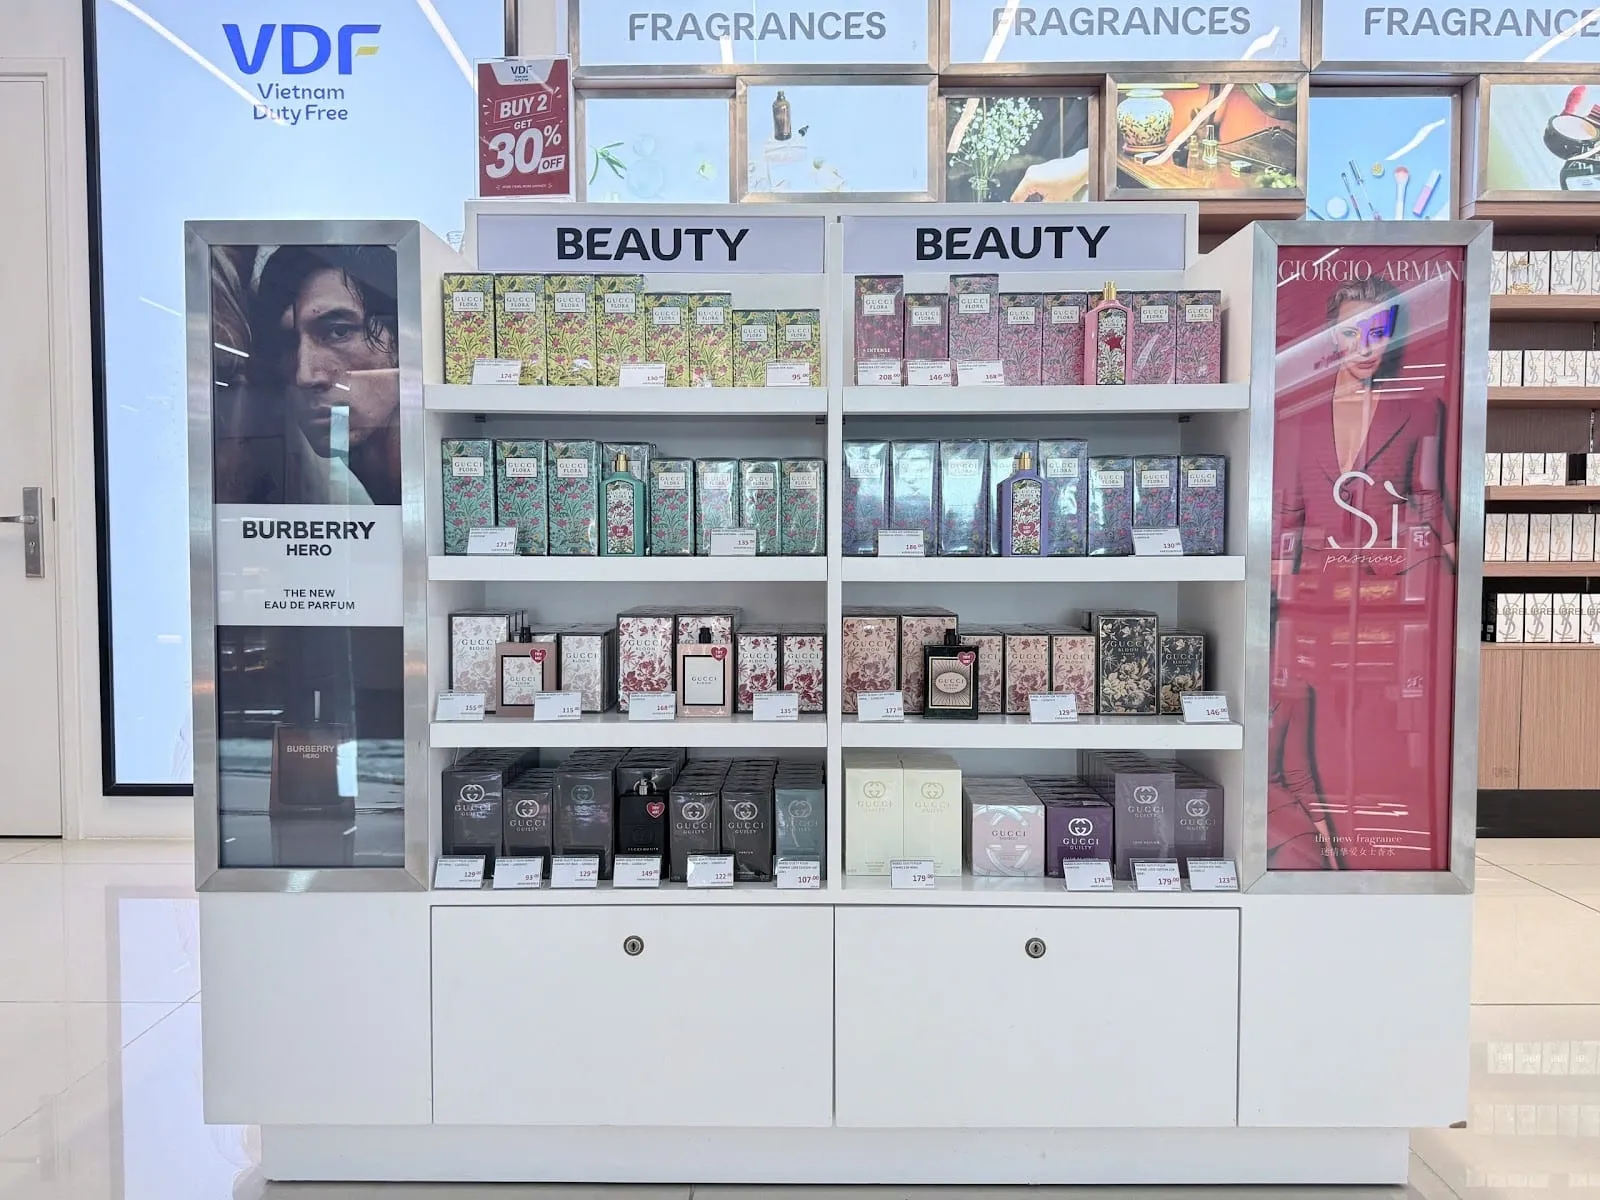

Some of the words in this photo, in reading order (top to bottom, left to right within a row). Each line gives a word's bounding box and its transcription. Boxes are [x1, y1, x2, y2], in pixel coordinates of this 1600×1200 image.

[629, 11, 886, 41] FRAGRANCES
[993, 6, 1250, 35] FRAGRANCES
[222, 24, 382, 75] VDF
[511, 65, 532, 75] VDF
[257, 83, 345, 100] Vietnam
[253, 104, 302, 125] Duty
[305, 104, 348, 120] Free
[500, 97, 535, 118] BUY
[537, 94, 547, 111] 2
[514, 119, 532, 129] GET
[542, 158, 563, 170] OFF
[556, 227, 749, 261] BEAUTY
[916, 225, 1110, 261] BEAUTY
[1279, 260, 1372, 282] GIORGIO
[1327, 471, 1409, 549] Sì
[242, 520, 376, 540] BURBERRY
[286, 544, 332, 556] HERO
[1323, 552, 1407, 573] passione
[284, 589, 306, 598] THE
[310, 589, 336, 598] NEW
[264, 600, 287, 610] EAU
[290, 600, 305, 610] DE
[308, 600, 355, 610] PARFUM
[286, 745, 335, 753] BURBERRY
[1063, 838, 1100, 846] GUCCI
[1316, 834, 1330, 843] the
[1356, 834, 1402, 846] fragrance
